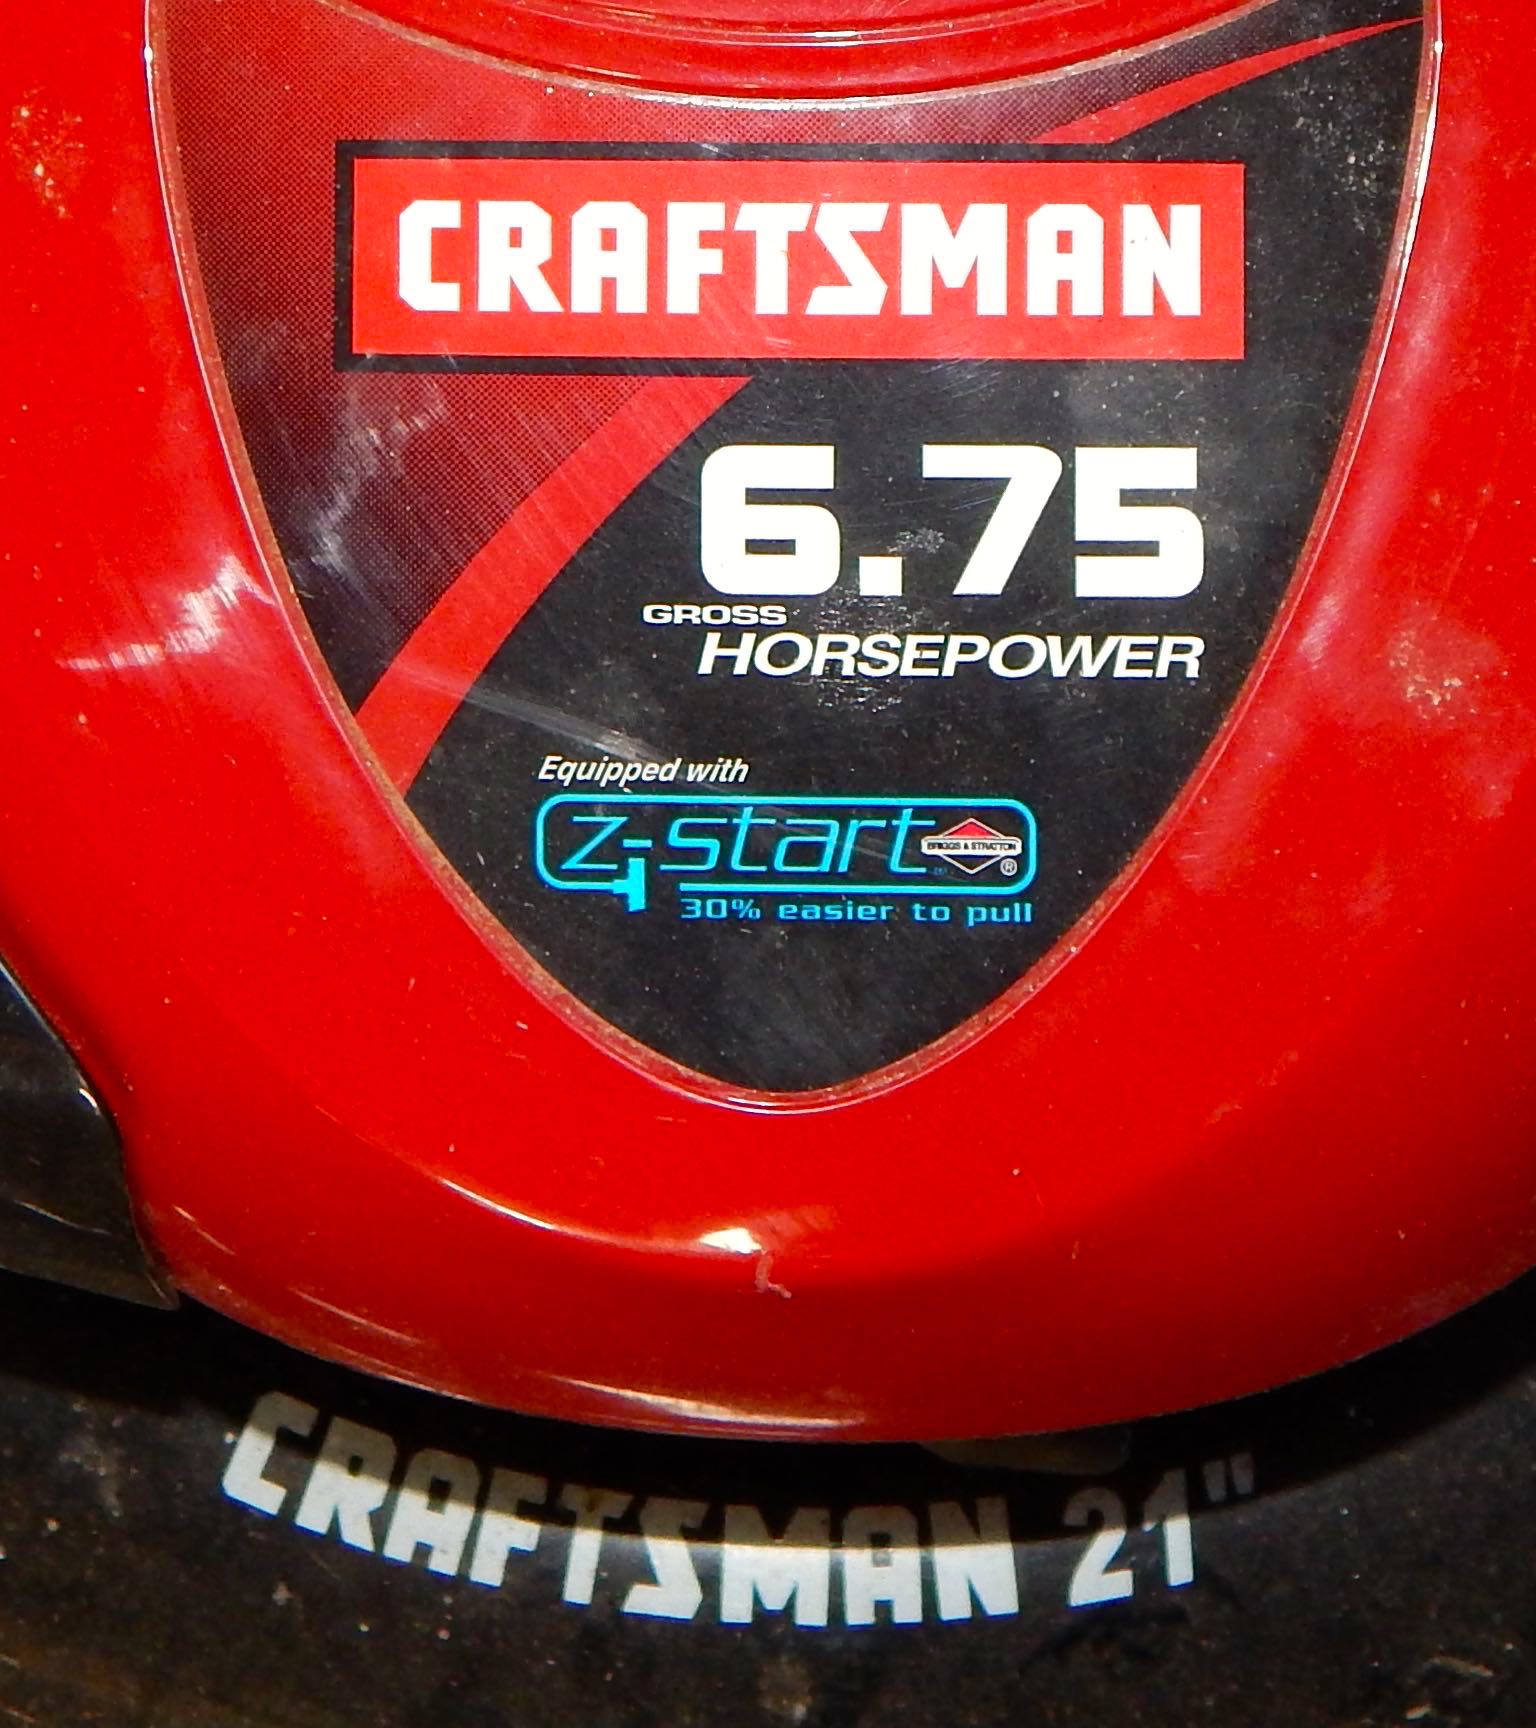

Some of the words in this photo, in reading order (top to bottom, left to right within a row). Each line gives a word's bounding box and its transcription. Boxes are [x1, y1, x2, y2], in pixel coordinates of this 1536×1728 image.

[398, 199, 1202, 318] CRAFTSMAN
[700, 444, 1205, 599] 6.75
[642, 604, 788, 626] GROSS
[698, 633, 1206, 679] HORSEPOWER
[538, 755, 678, 788] Equipped
[687, 758, 750, 783] with
[680, 897, 762, 920] 30%
[778, 899, 894, 922] easier
[912, 901, 951, 923] to
[967, 902, 1033, 927] pull
[221, 1391, 1020, 1628] CRAFTSMAN
[1064, 1451, 1255, 1607] 21"
